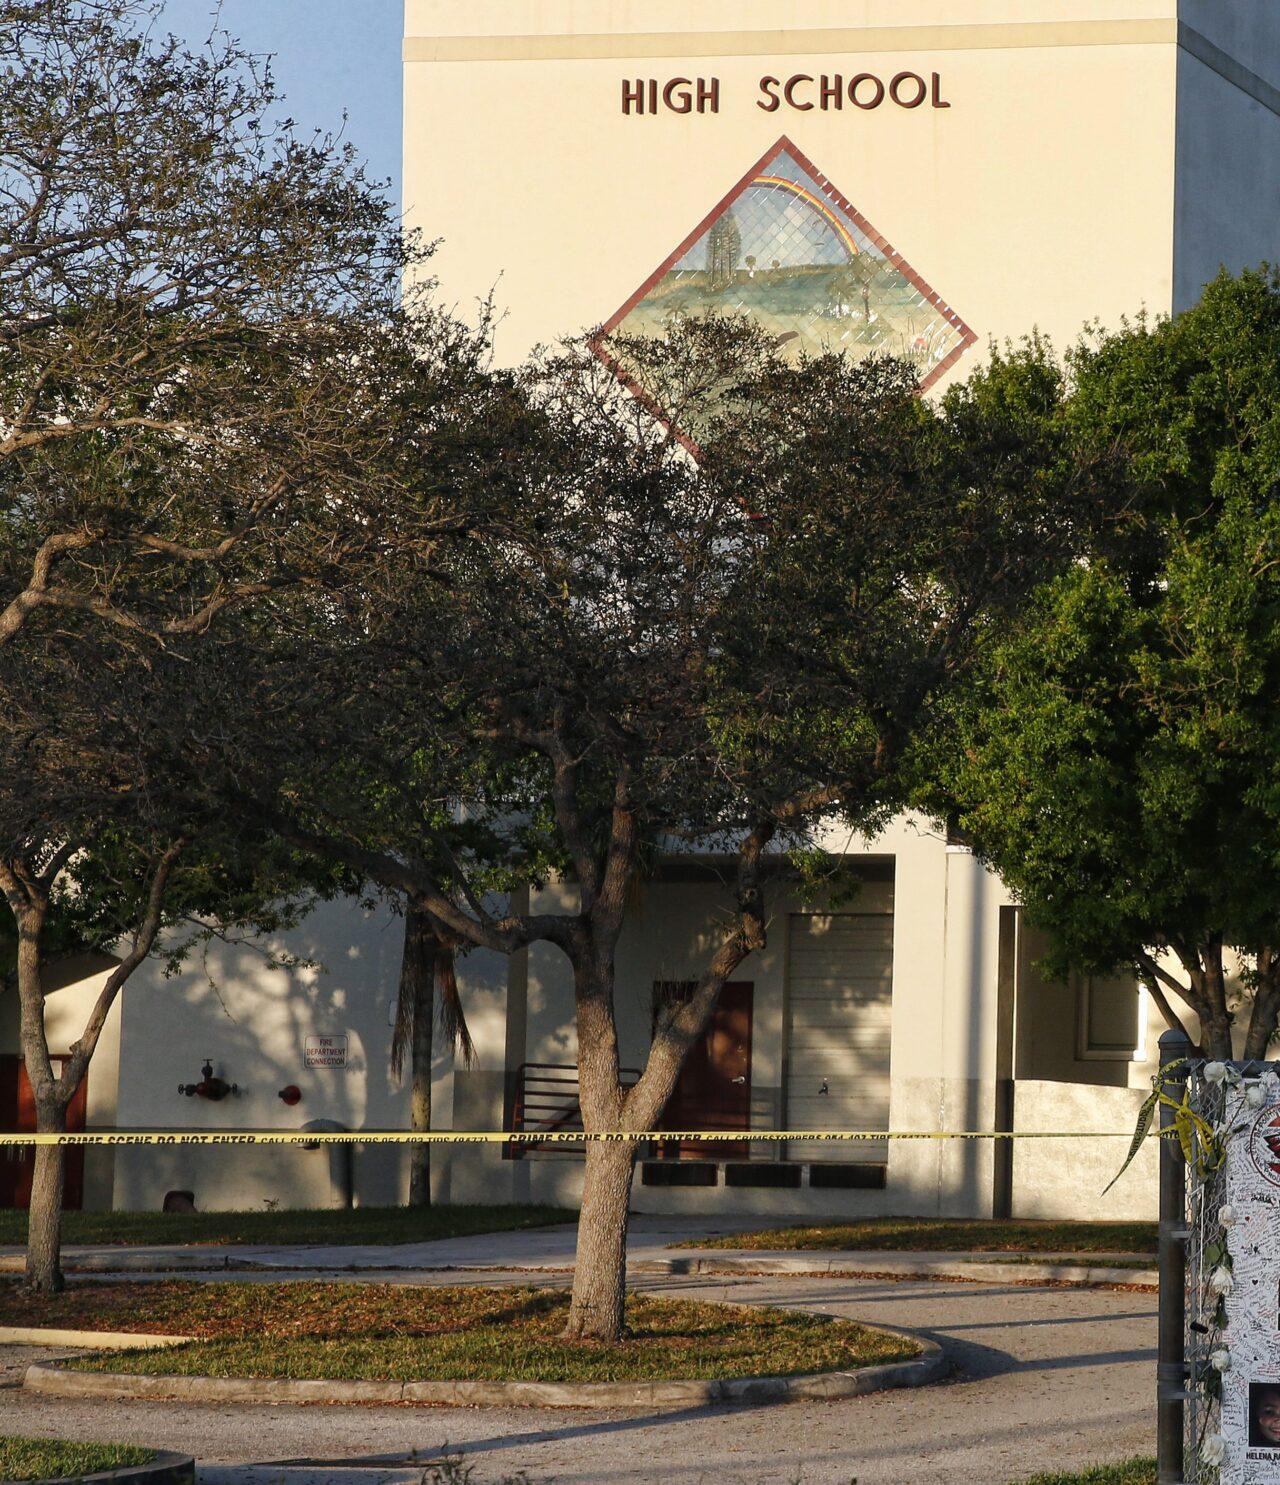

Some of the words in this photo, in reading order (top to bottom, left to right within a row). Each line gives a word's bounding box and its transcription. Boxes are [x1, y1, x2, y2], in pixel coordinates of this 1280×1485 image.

[622, 77, 720, 115] HIGH
[756, 71, 951, 112] SCHOOL
[306, 1048, 346, 1056] DEPARTMENT
[306, 1057, 345, 1065] CONNECTION
[58, 1136, 103, 1144] CRIME
[108, 1136, 152, 1144] SCENE
[157, 1136, 176, 1144] DO
[180, 1136, 209, 1144] NOT
[212, 1135, 256, 1144] ENTER
[628, 1133, 656, 1141] NOT
[659, 1133, 702, 1141] ENTER
[1246, 1451, 1273, 1461] HELENA
